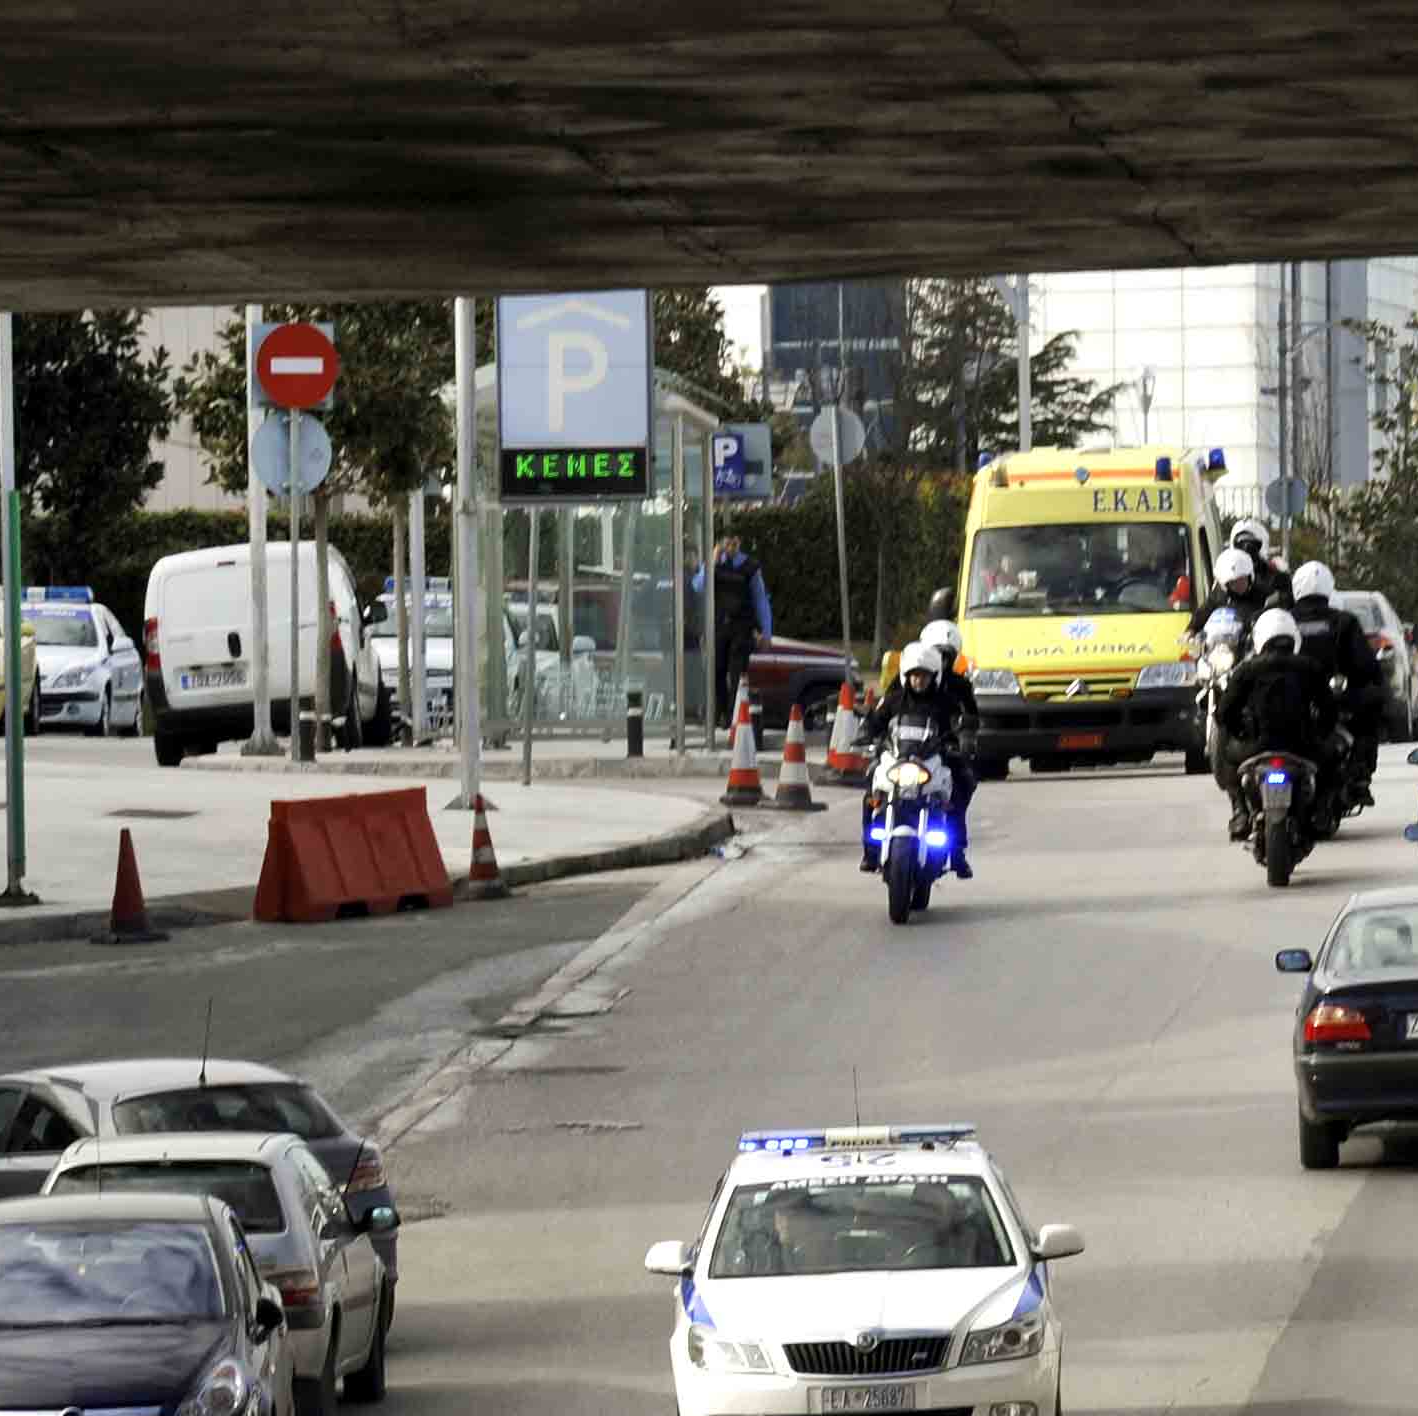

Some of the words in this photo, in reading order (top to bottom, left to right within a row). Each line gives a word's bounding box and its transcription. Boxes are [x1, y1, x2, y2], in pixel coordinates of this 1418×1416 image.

[548, 331, 608, 433] P
[515, 452, 636, 478] ΚΕΝΕΣ
[714, 436, 738, 465] P
